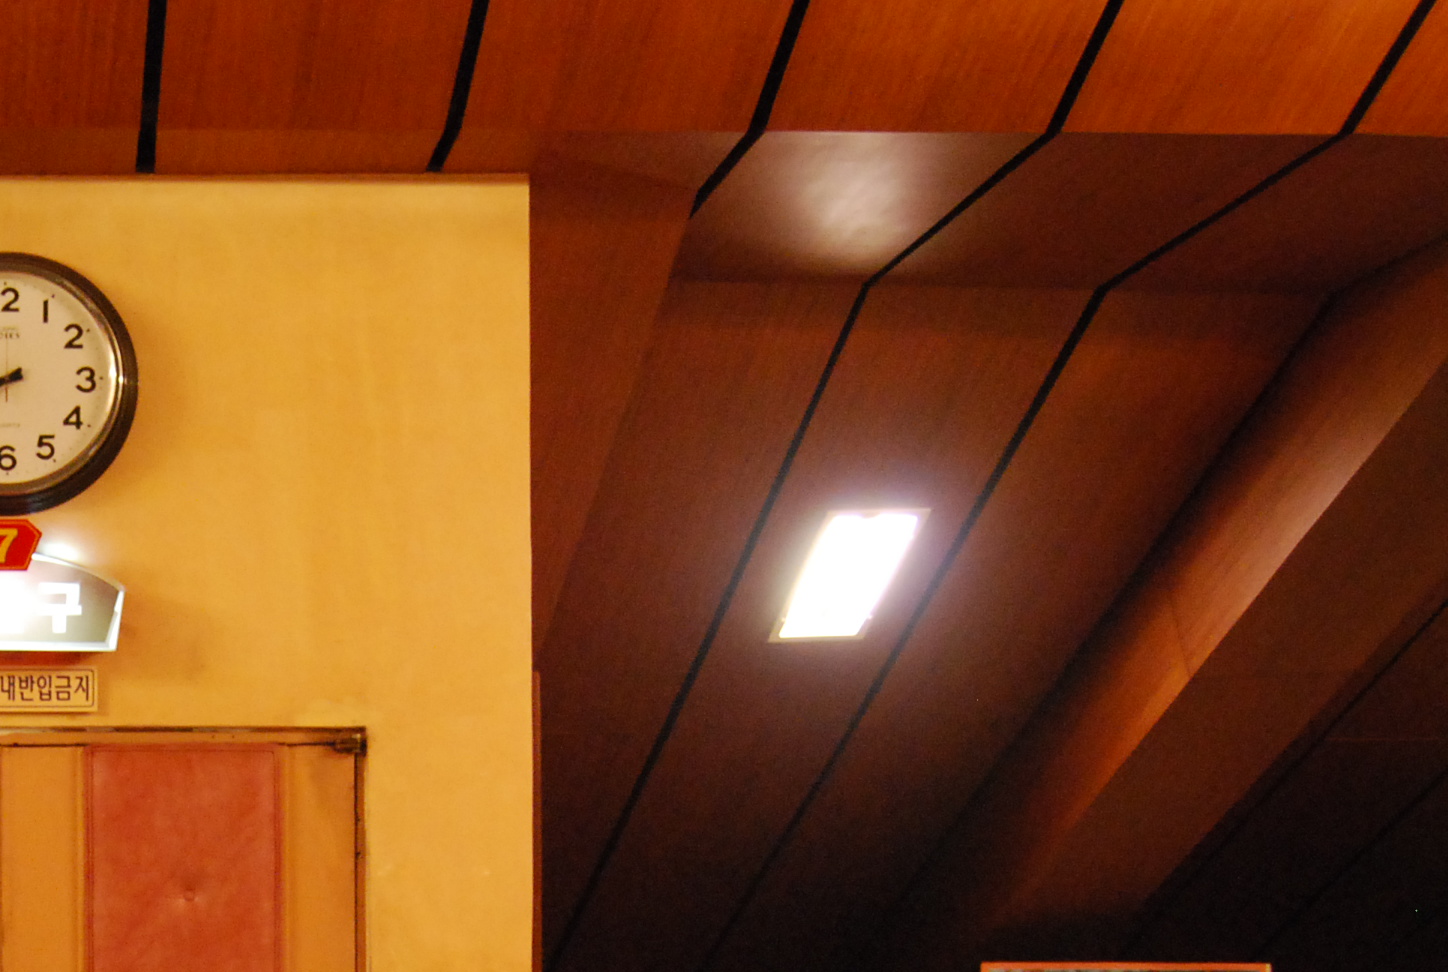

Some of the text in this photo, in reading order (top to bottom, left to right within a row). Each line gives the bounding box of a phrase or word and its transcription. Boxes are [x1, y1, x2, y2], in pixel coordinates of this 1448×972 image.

[43, 299, 49, 323] 1
[63, 324, 84, 349] 2
[75, 366, 96, 393] 3
[62, 405, 83, 430] 4
[36, 435, 55, 460] 5
